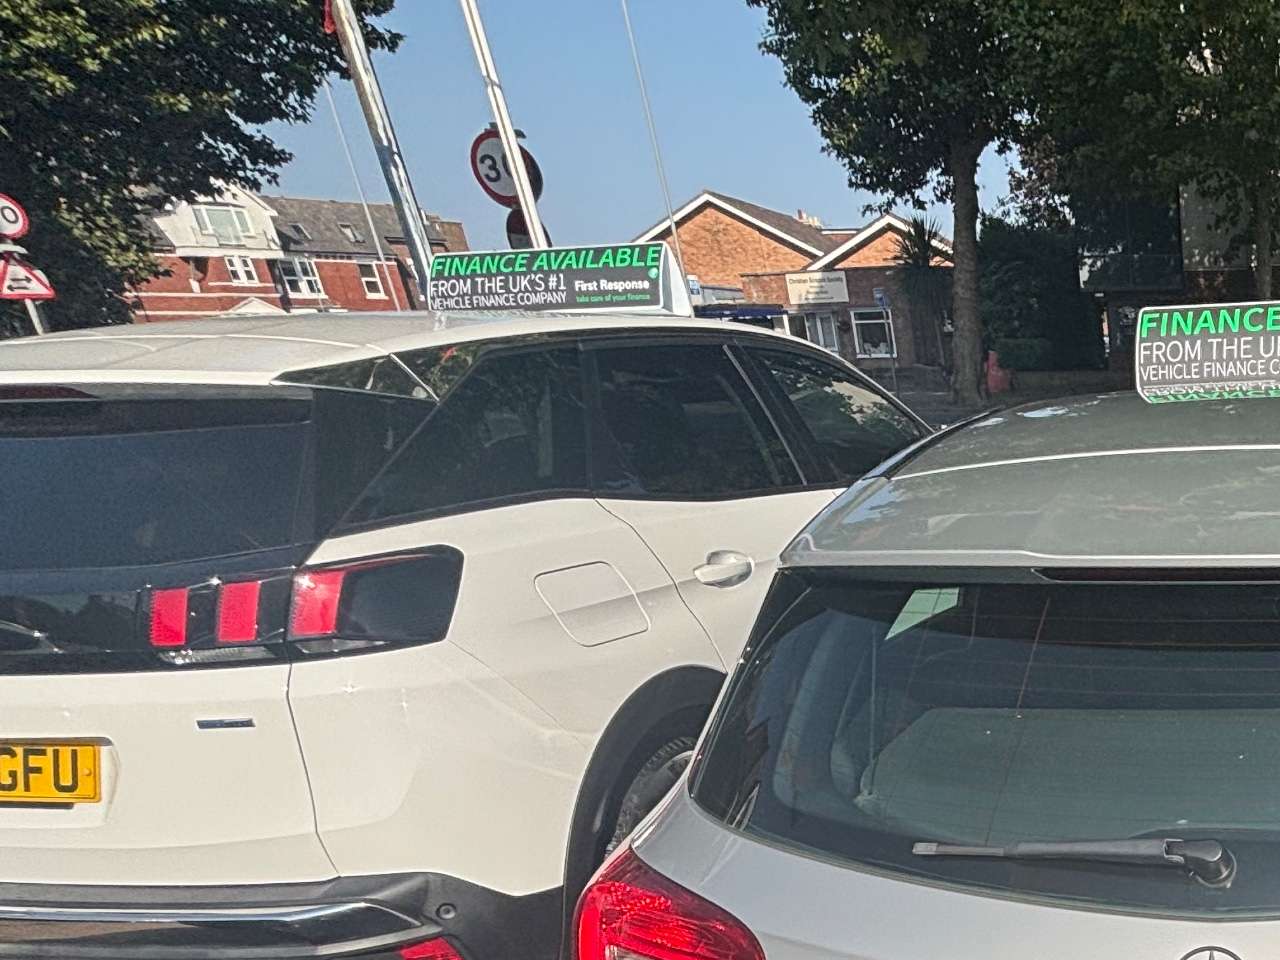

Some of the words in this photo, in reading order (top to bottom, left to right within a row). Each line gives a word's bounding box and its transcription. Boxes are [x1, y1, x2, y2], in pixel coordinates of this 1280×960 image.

[432, 253, 530, 278] FINANCE
[532, 246, 661, 271] AVAILABLE
[430, 278, 471, 297] FROM
[475, 276, 505, 293] THE
[509, 273, 545, 291] UK'S
[548, 273, 566, 290] #1
[574, 280, 598, 292] First
[600, 279, 650, 292] Response
[431, 296, 471, 310] VEHICLE
[473, 293, 516, 307] FINANCE
[517, 291, 567, 305] COMPANY
[1140, 339, 1201, 364] FROM
[1208, 337, 1253, 360] THE
[1140, 362, 1200, 382] VEHICLE
[1203, 359, 1266, 378] FINANCE
[0, 747, 79, 793] GFU
